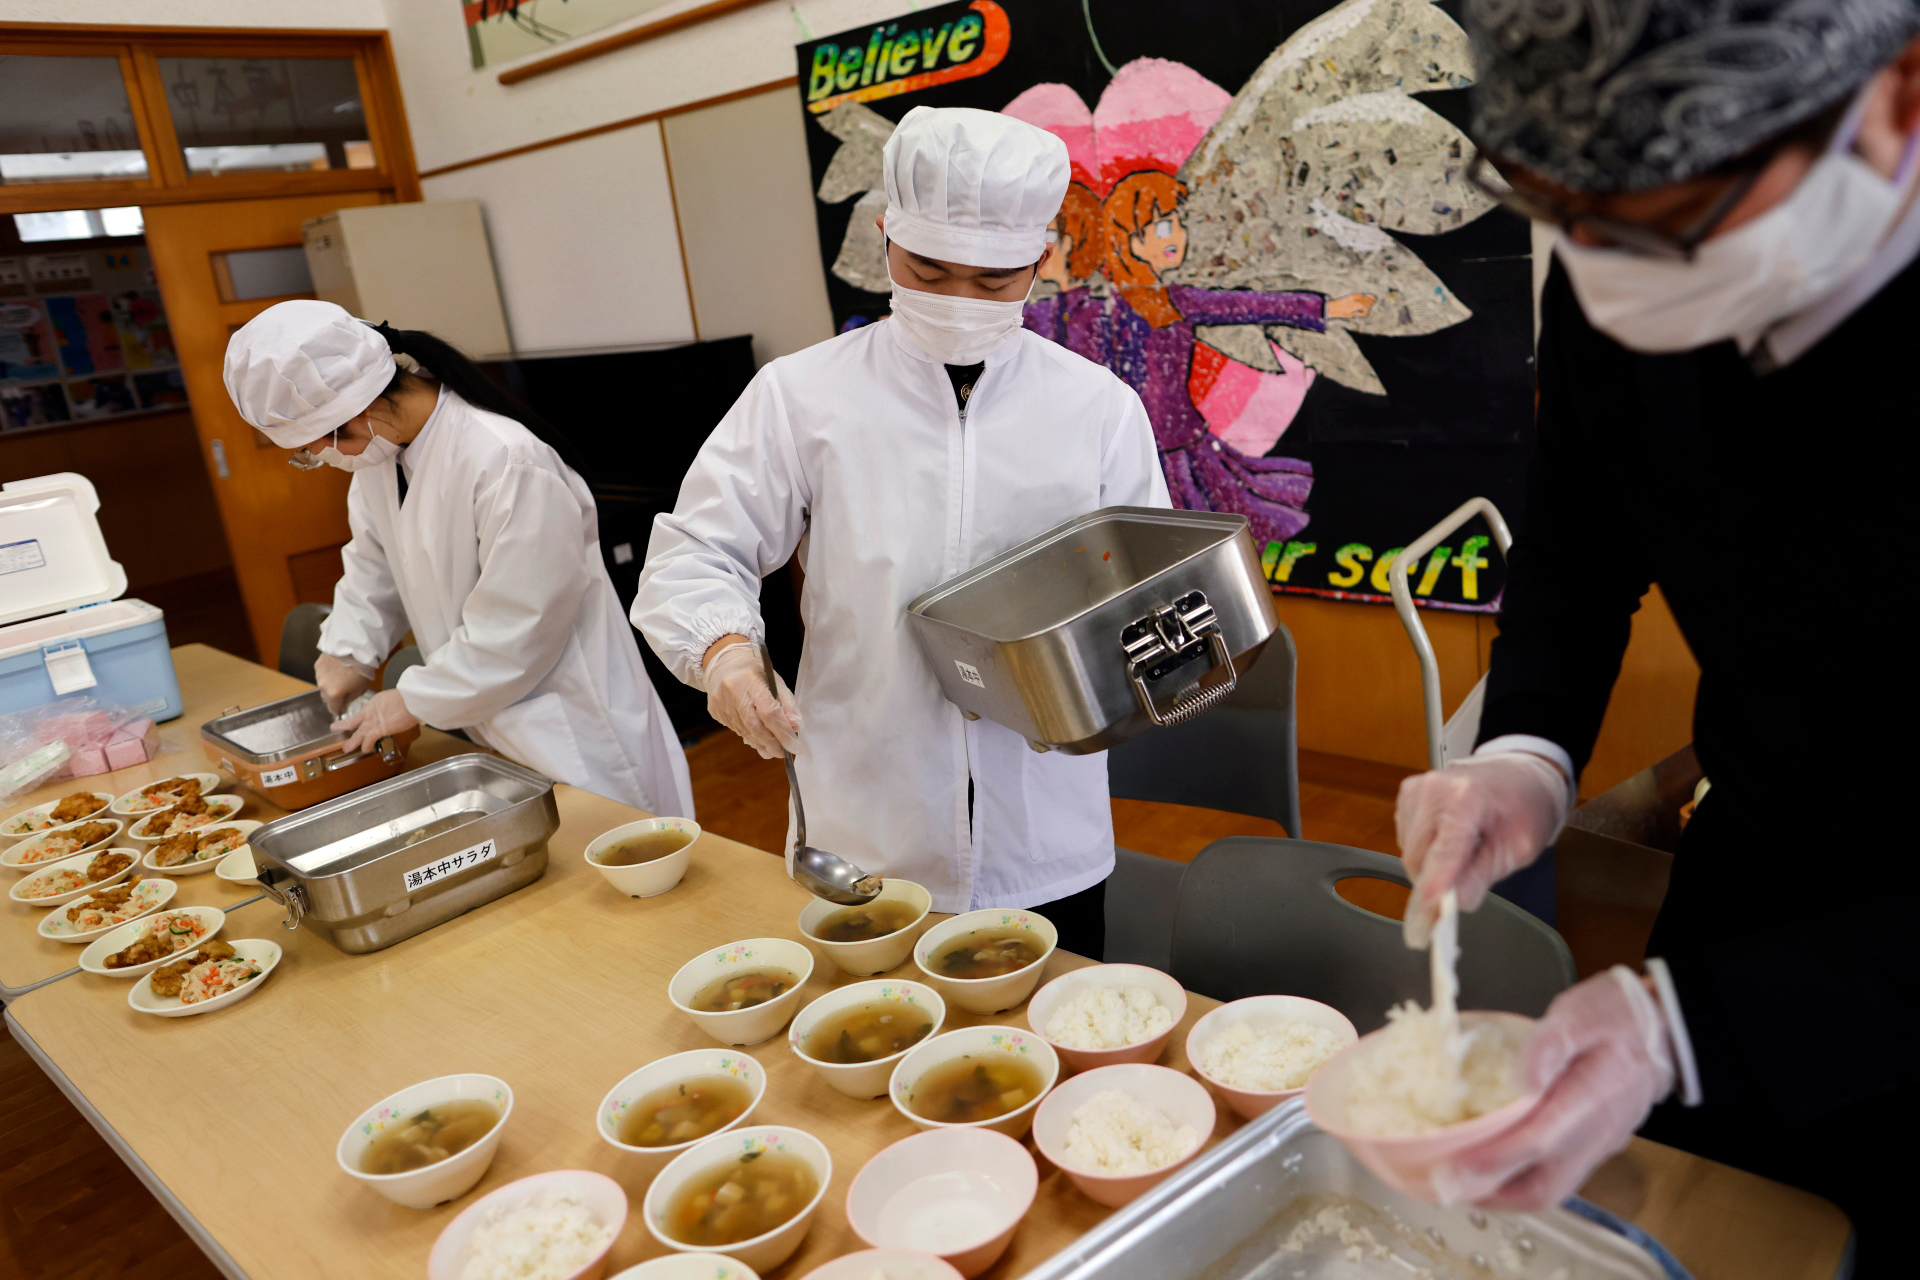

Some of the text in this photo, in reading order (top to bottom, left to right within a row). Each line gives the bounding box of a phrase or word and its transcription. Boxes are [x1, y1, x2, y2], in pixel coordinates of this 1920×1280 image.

[807, 14, 981, 101] Believe
[264, 770, 294, 784] 湯本中
[407, 842, 492, 888] 湯本中サラダ
